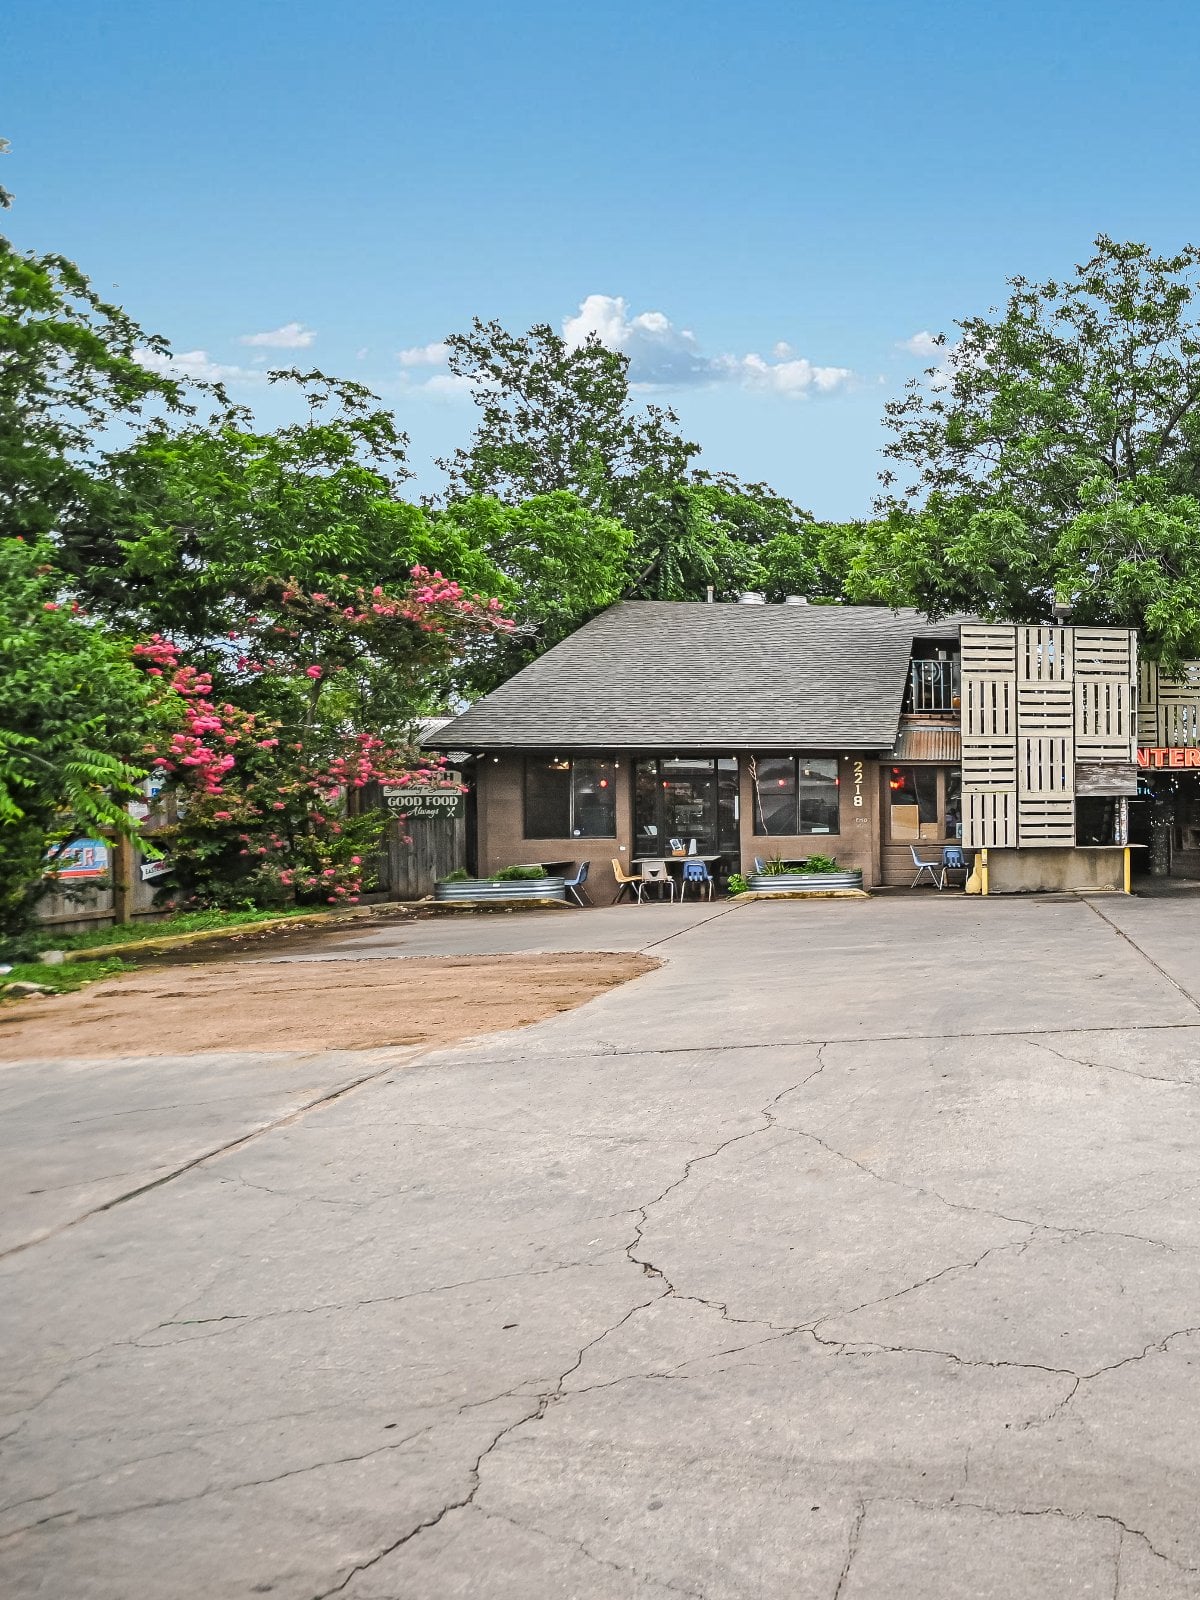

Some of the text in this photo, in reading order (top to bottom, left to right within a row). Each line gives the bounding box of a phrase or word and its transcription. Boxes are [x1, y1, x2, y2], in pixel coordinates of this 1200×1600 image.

[853, 761, 863, 807] 2218
[387, 796, 459, 807] GOOD FOOD
[407, 806, 439, 818] Always
